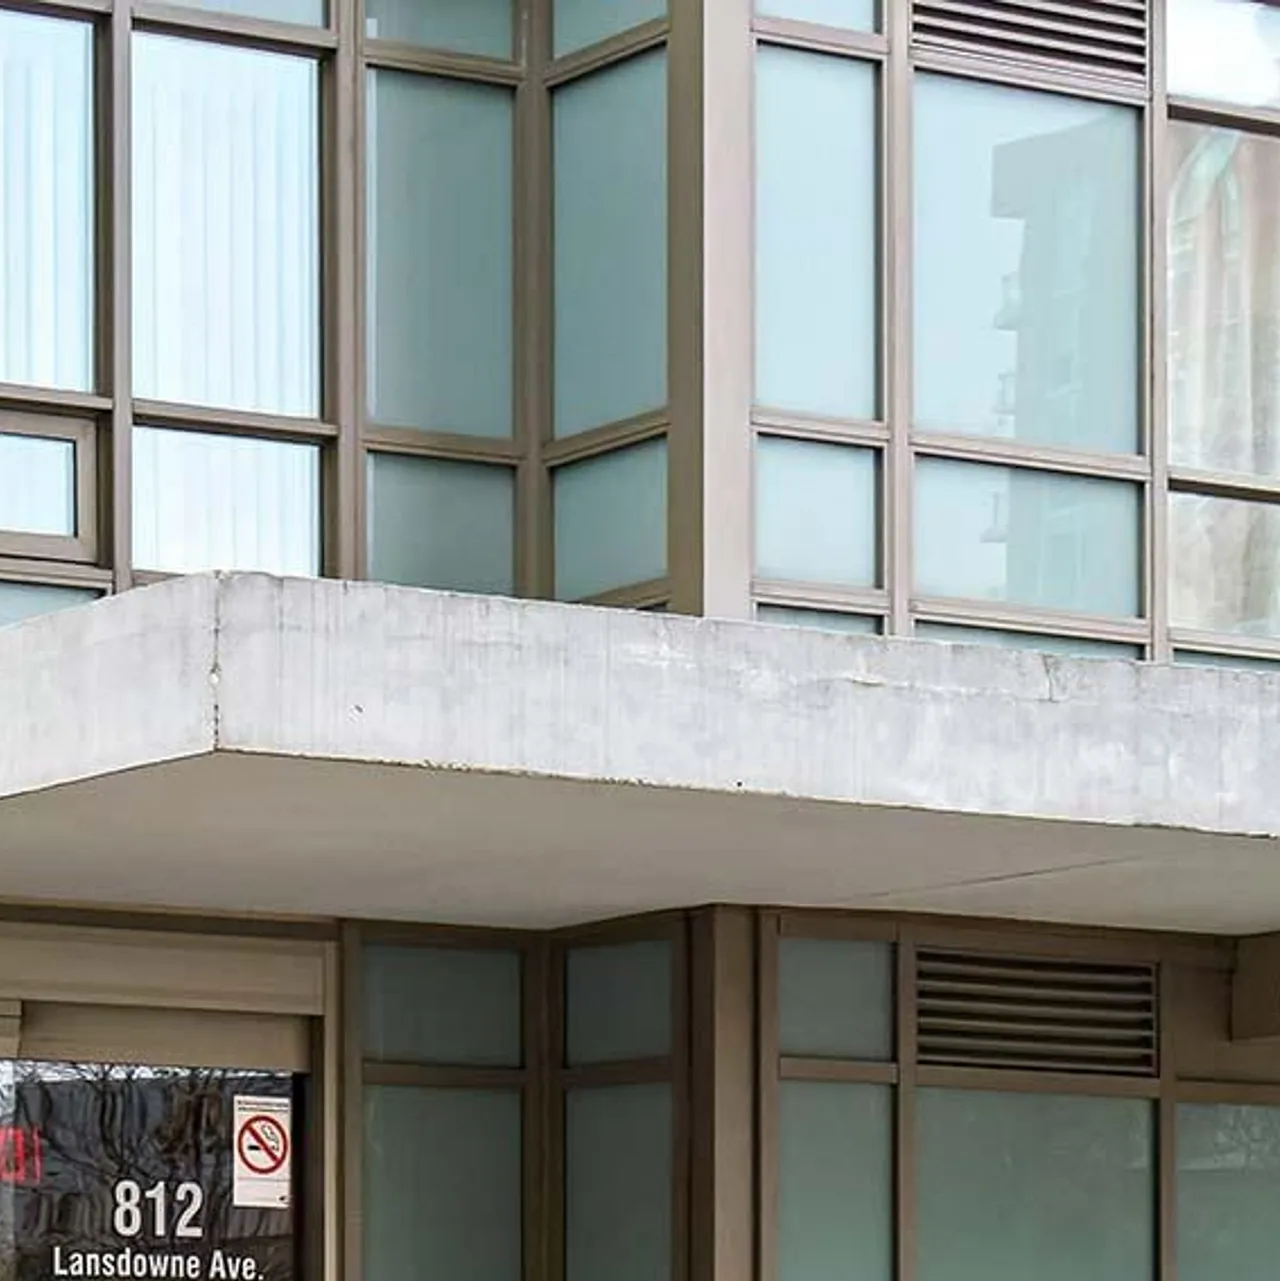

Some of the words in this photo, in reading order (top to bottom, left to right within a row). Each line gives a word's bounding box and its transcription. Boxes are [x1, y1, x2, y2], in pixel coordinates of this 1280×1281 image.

[114, 1180, 203, 1237] 812
[54, 1246, 200, 1278] Lansdowne
[209, 1250, 264, 1281] Ave.
